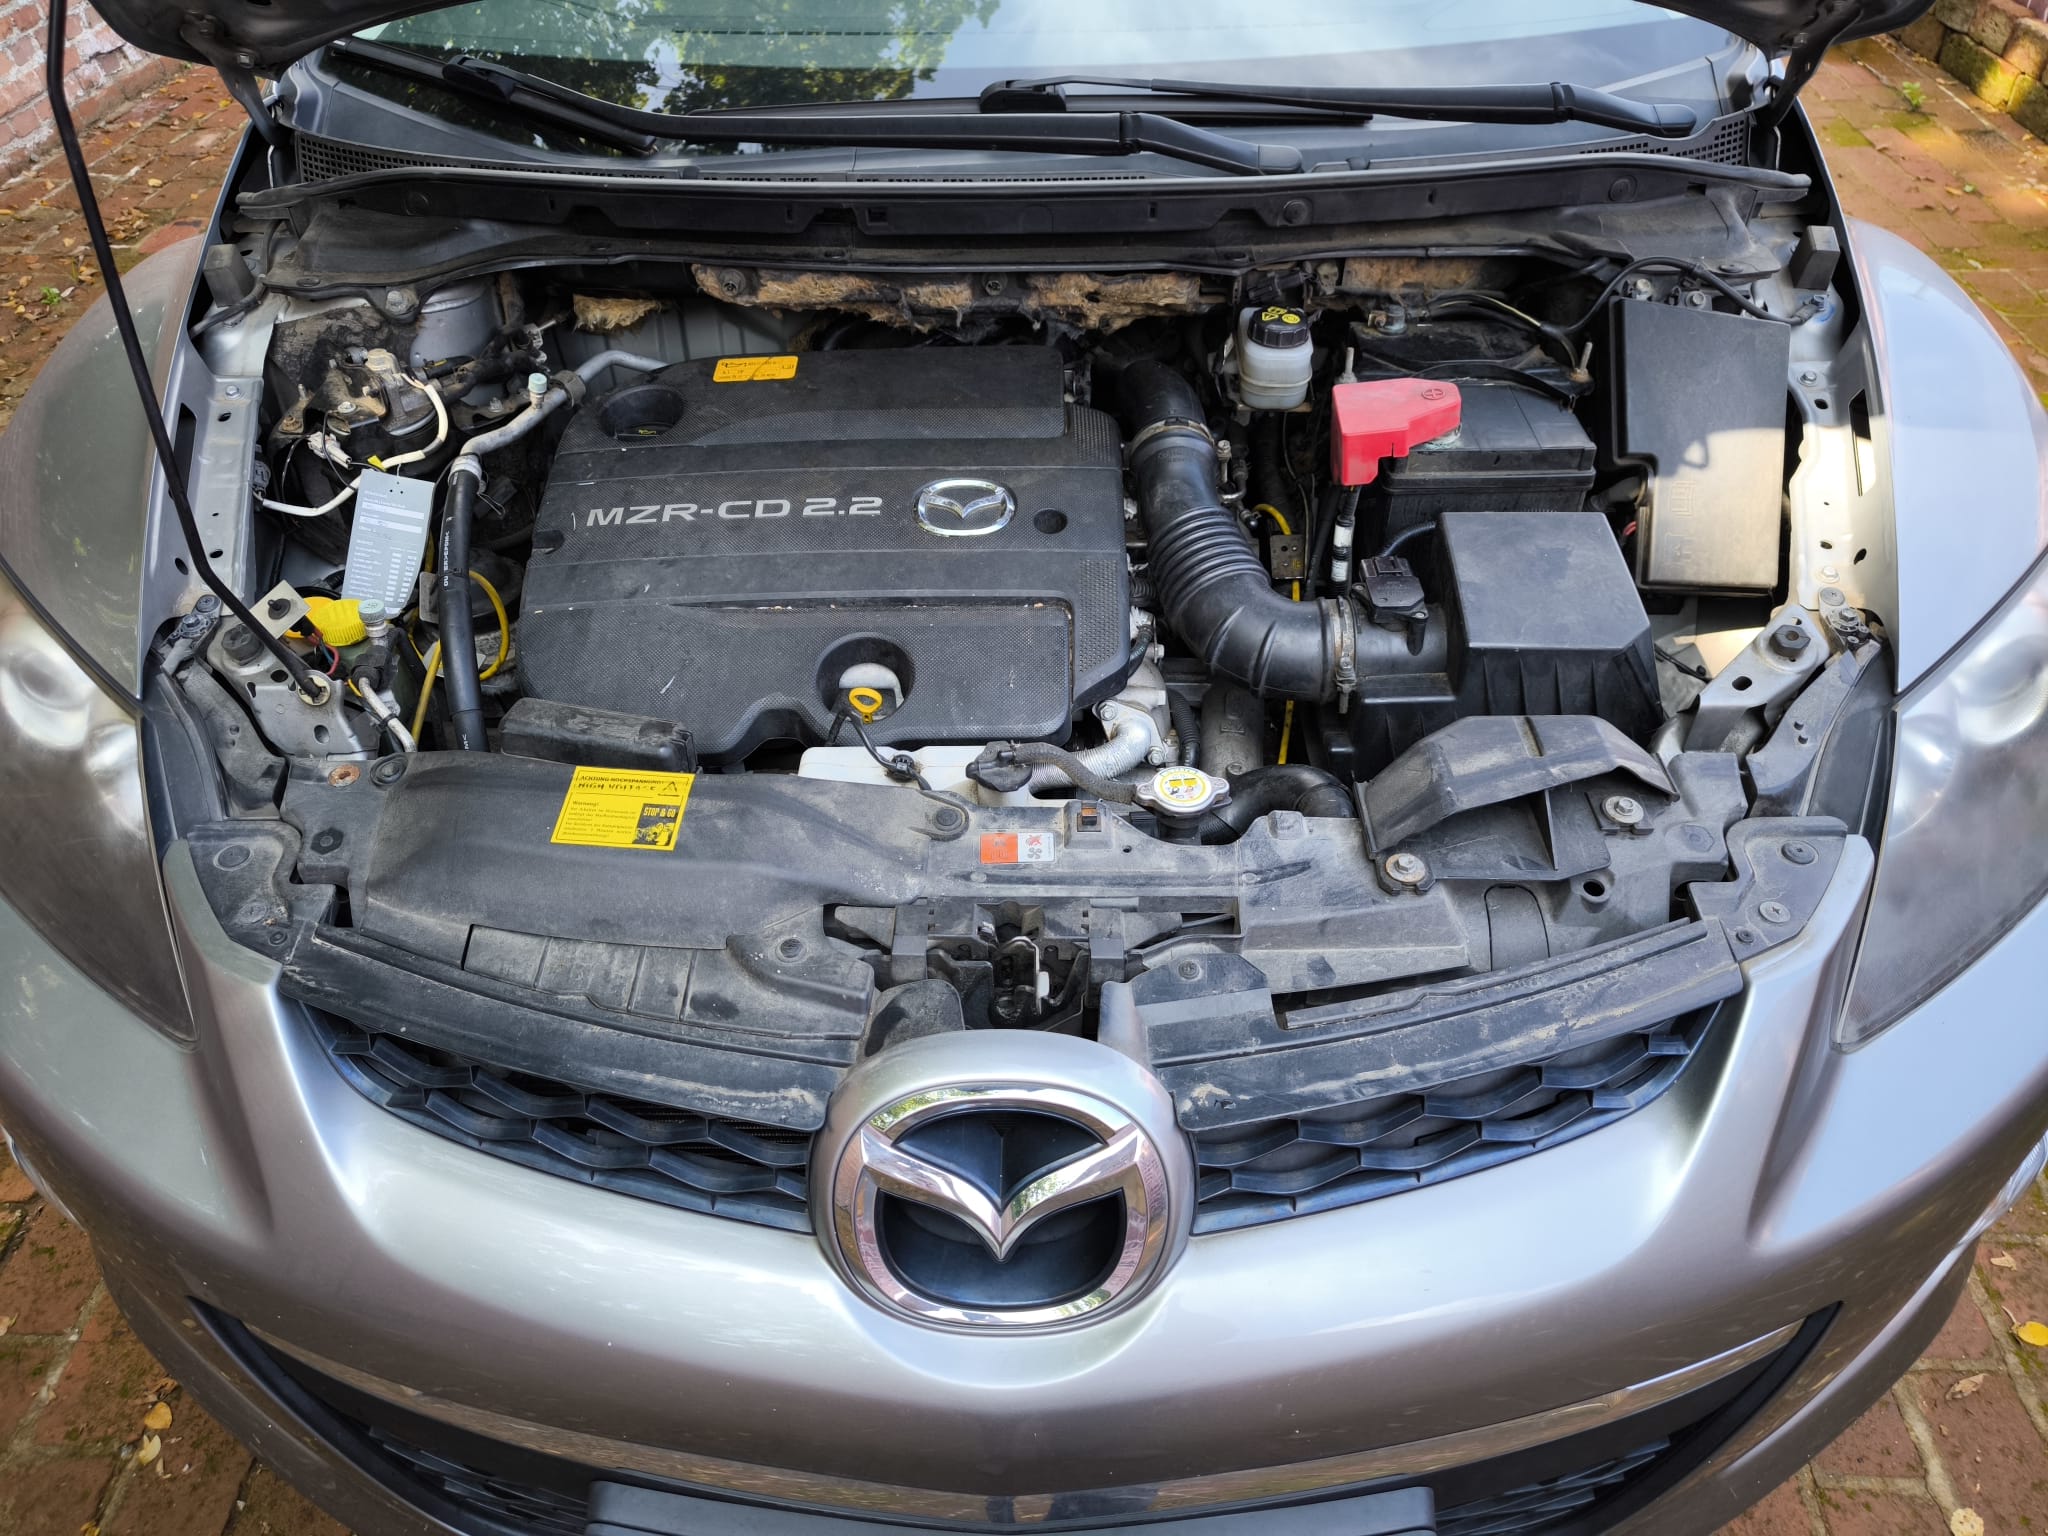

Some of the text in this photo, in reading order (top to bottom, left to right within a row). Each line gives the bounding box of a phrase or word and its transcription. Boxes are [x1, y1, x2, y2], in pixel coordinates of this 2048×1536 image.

[586, 497, 883, 527] MZR-CD 2.2
[643, 807, 660, 817] STOP
[667, 808, 676, 818] GO
